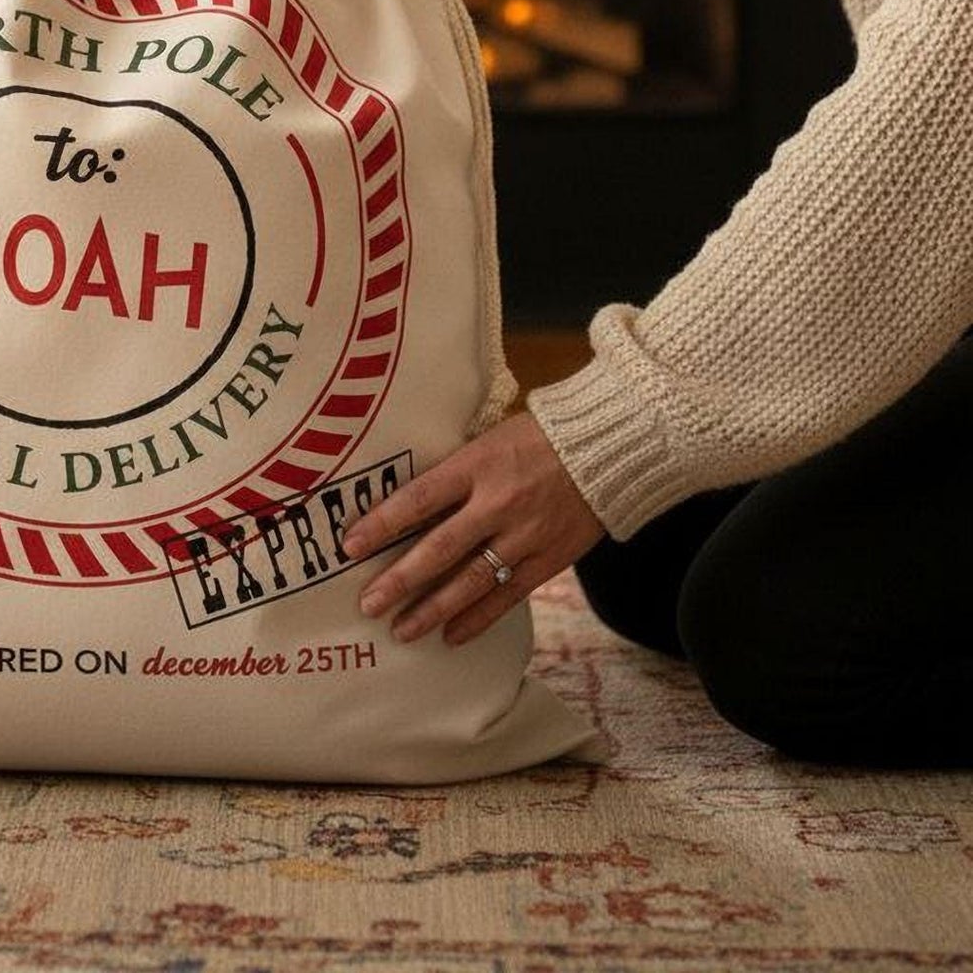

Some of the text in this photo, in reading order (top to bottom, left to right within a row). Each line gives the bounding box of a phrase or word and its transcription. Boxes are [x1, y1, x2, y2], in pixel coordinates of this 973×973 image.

[120, 35, 284, 122] POLE
[34, 127, 125, 183] to:
[62, 302, 304, 494] DELIVERY
[75, 649, 127, 675] ON
[142, 646, 289, 676] december
[297, 642, 376, 674] 25TH
